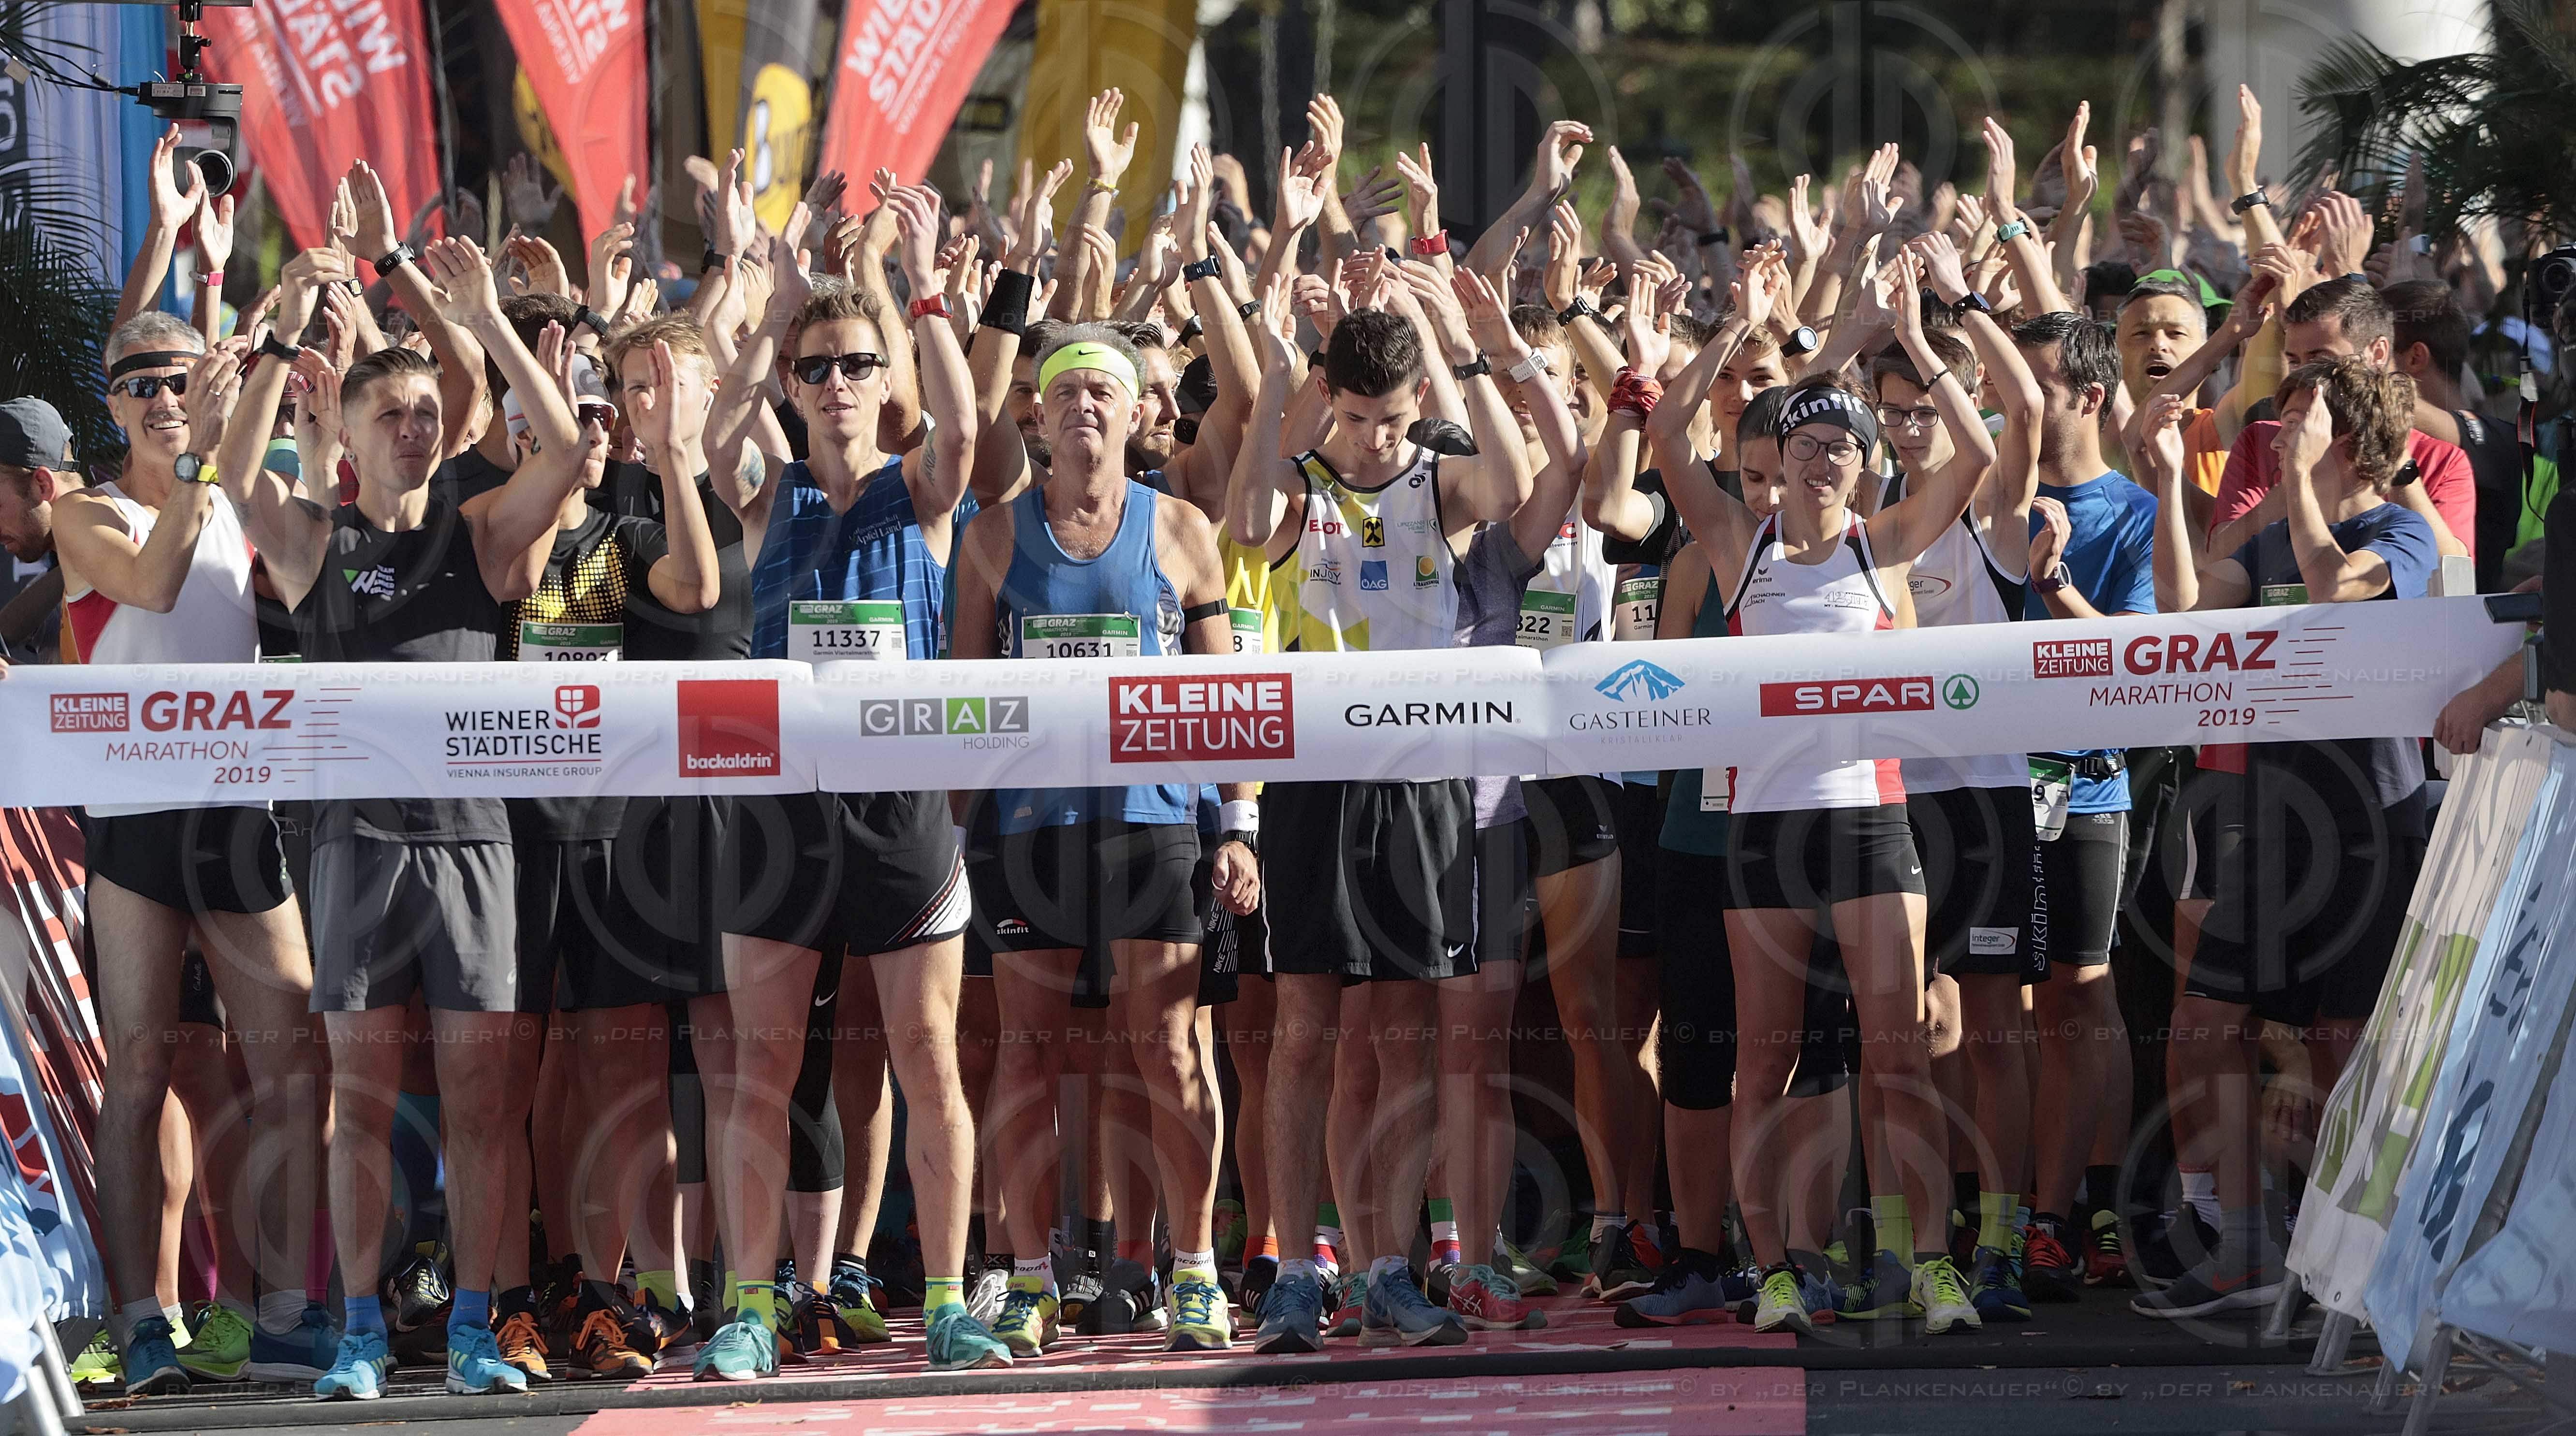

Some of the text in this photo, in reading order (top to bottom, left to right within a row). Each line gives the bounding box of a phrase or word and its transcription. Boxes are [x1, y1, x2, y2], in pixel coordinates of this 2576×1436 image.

[1782, 393, 1864, 435] skinfit
[878, 520, 902, 537] Land
[1310, 568, 1342, 581] INJOY
[1632, 580, 1658, 591] GRAZ
[814, 605, 843, 614] GRAZ
[1048, 618, 1077, 627] GRAZ
[548, 627, 577, 636] GRAZ
[812, 630, 880, 647] 11337
[1046, 642, 1113, 658] 10631
[2036, 642, 2109, 658] KLEINE
[2123, 630, 2279, 676] GRAZ
[2037, 657, 2109, 675] ZEITUNG
[1119, 681, 1284, 715] KLEINE
[1795, 682, 1931, 711] SPAR
[2089, 682, 2232, 707] MARATHON
[54, 696, 126, 712] KLEINE
[141, 690, 295, 731] GRAZ
[54, 713, 126, 729] ZEITUNG
[446, 710, 550, 731] WIENER
[864, 699, 1021, 733] GRAZ
[1569, 707, 1712, 731] GASTEINER
[2197, 708, 2255, 727] 2019
[1120, 715, 1285, 753] ZEITUNG
[1600, 734, 1683, 744] KRISTALLKLAR
[105, 741, 249, 761] MARATHON
[446, 733, 601, 757] STÄDTISCHE
[963, 736, 1030, 750] HOLDING
[213, 766, 271, 783] 2019
[447, 766, 602, 778] VIENNA INSURANCE GROUP
[1207, 912, 1219, 932] NIKE
[996, 927, 1029, 935] skinfit
[1972, 934, 2000, 943] integer
[1213, 954, 1226, 973] NIKE
